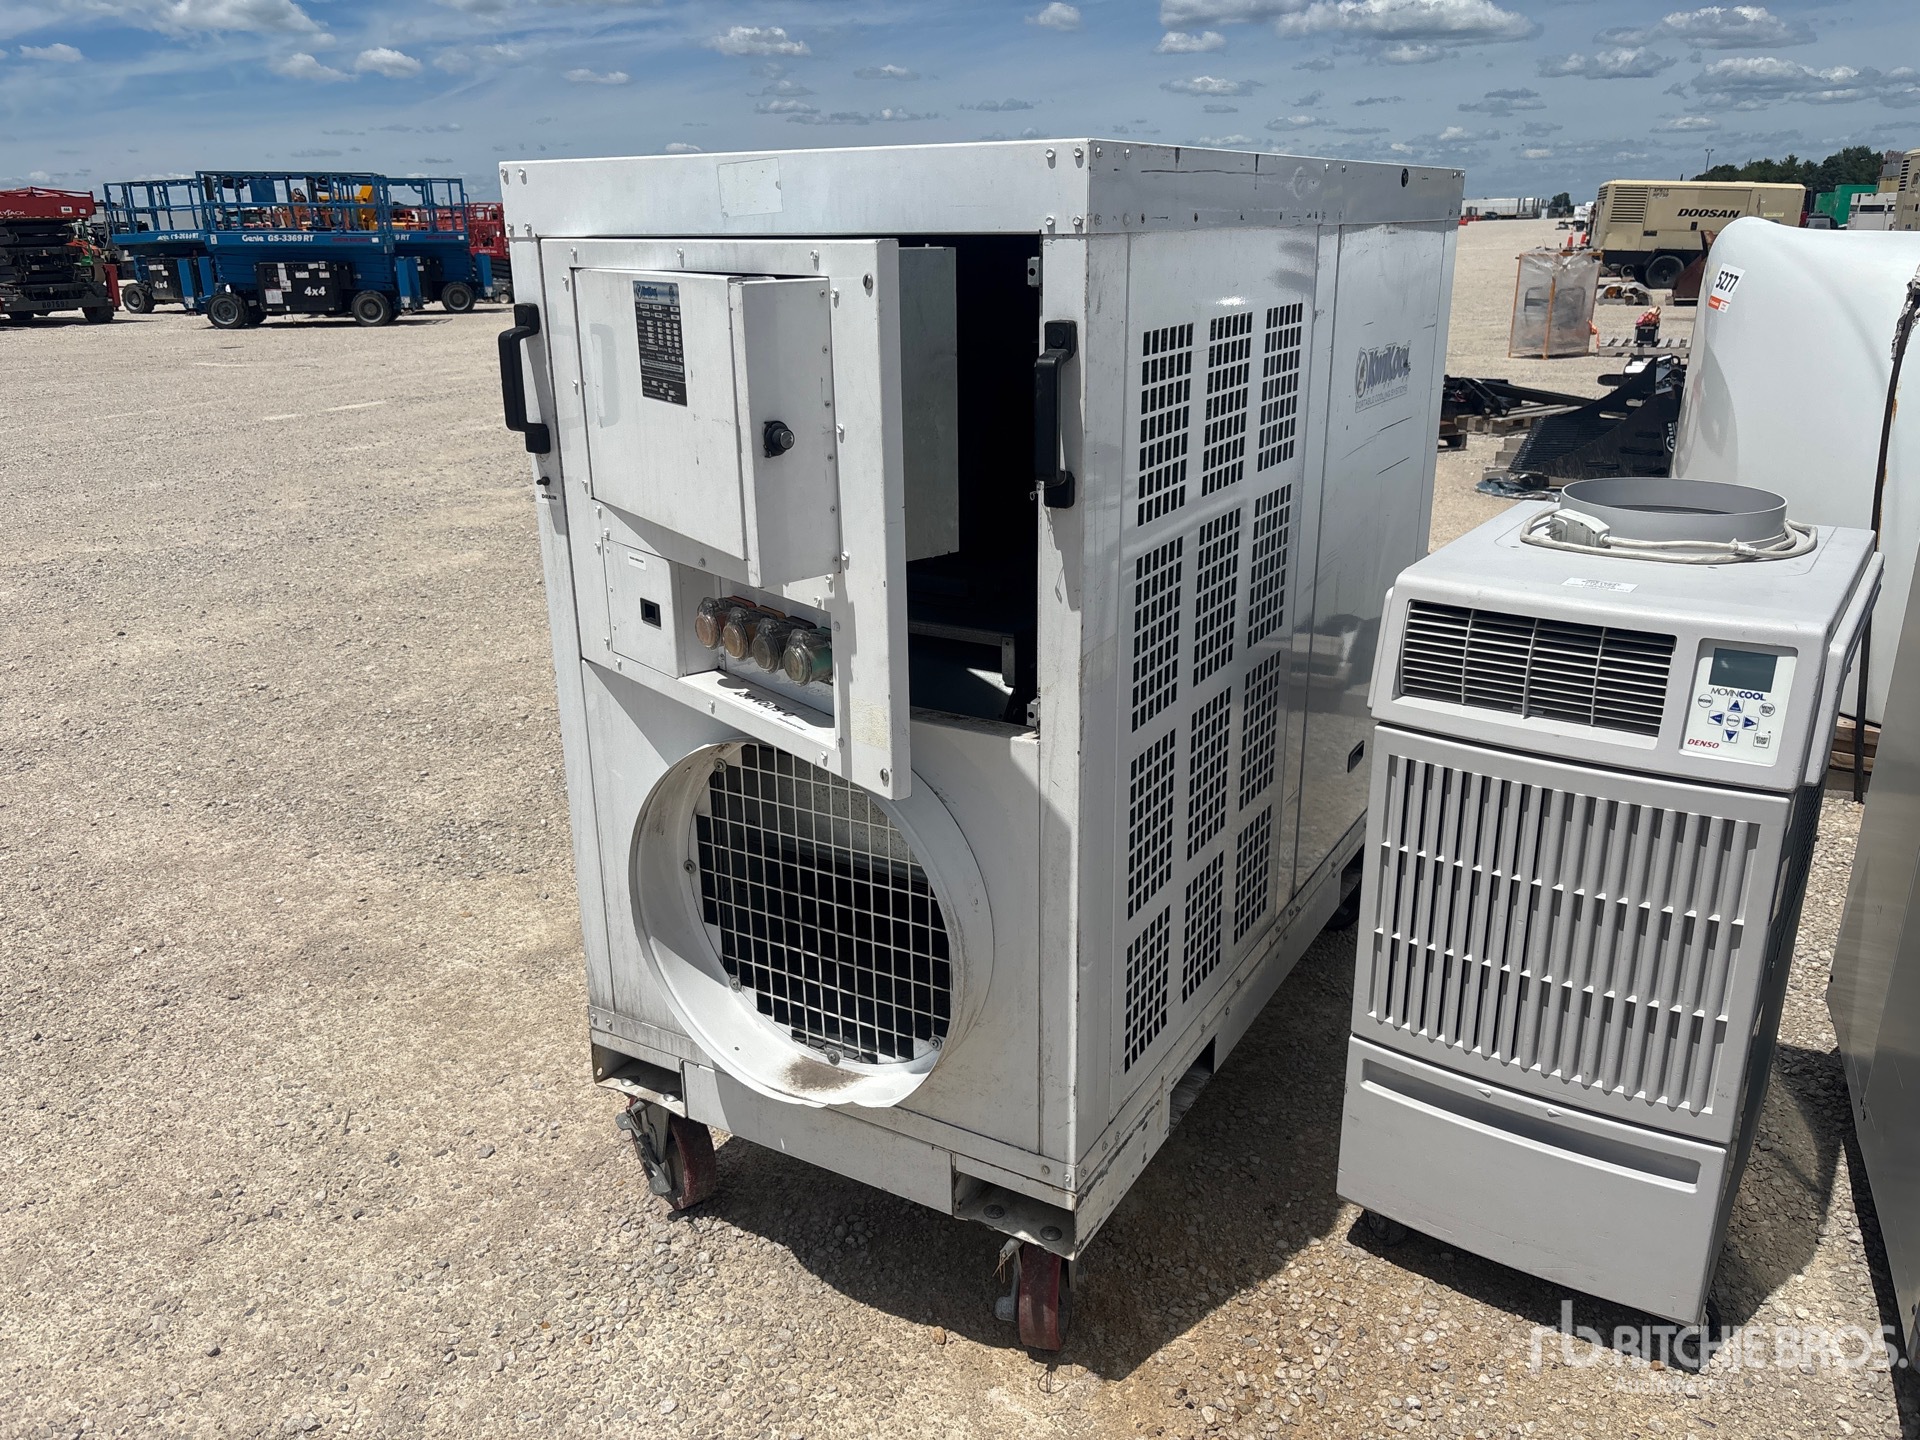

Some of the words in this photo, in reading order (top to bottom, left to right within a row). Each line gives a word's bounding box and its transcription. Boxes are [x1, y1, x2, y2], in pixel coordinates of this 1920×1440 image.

[1677, 208, 1741, 218] DOOSAN
[241, 234, 264, 242] Genie
[267, 234, 303, 242] GS-3369
[303, 234, 314, 242] RT
[154, 280, 168, 289] 4x4
[1715, 270, 1739, 293] 5277
[304, 286, 326, 296] 4x4
[1710, 687, 1766, 701] MOVINCOOL
[1687, 738, 1720, 749] DENSO
